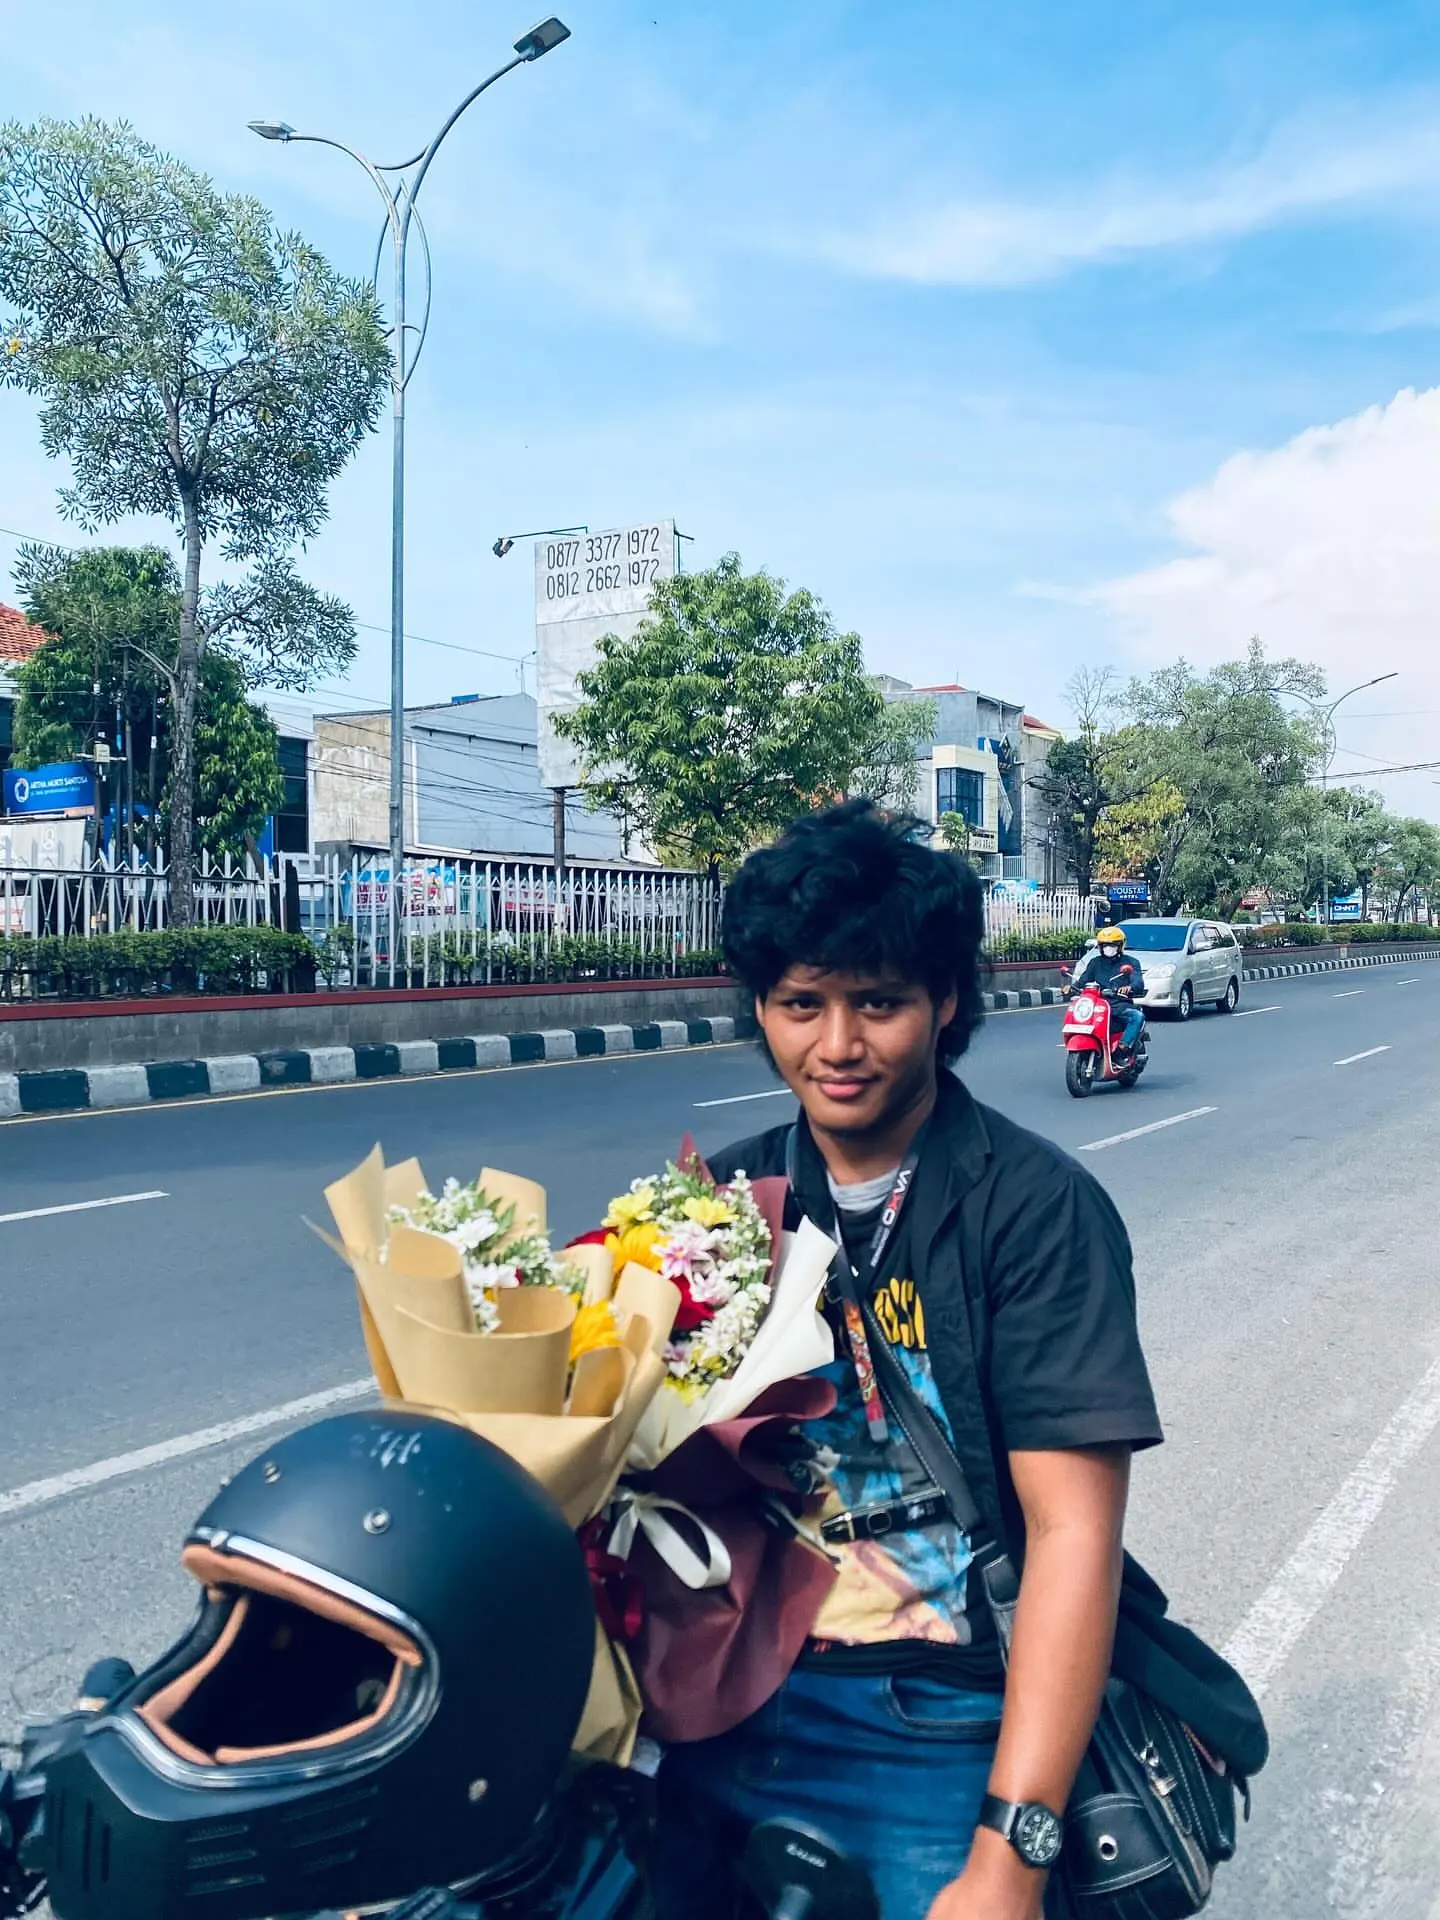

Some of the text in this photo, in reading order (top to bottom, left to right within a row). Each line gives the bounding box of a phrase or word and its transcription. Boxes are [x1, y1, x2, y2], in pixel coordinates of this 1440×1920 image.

[547, 527, 660, 570] 0877 3377 1972
[546, 558, 660, 600] 0812 2662 1972
[882, 1169, 912, 1225] OXVA
